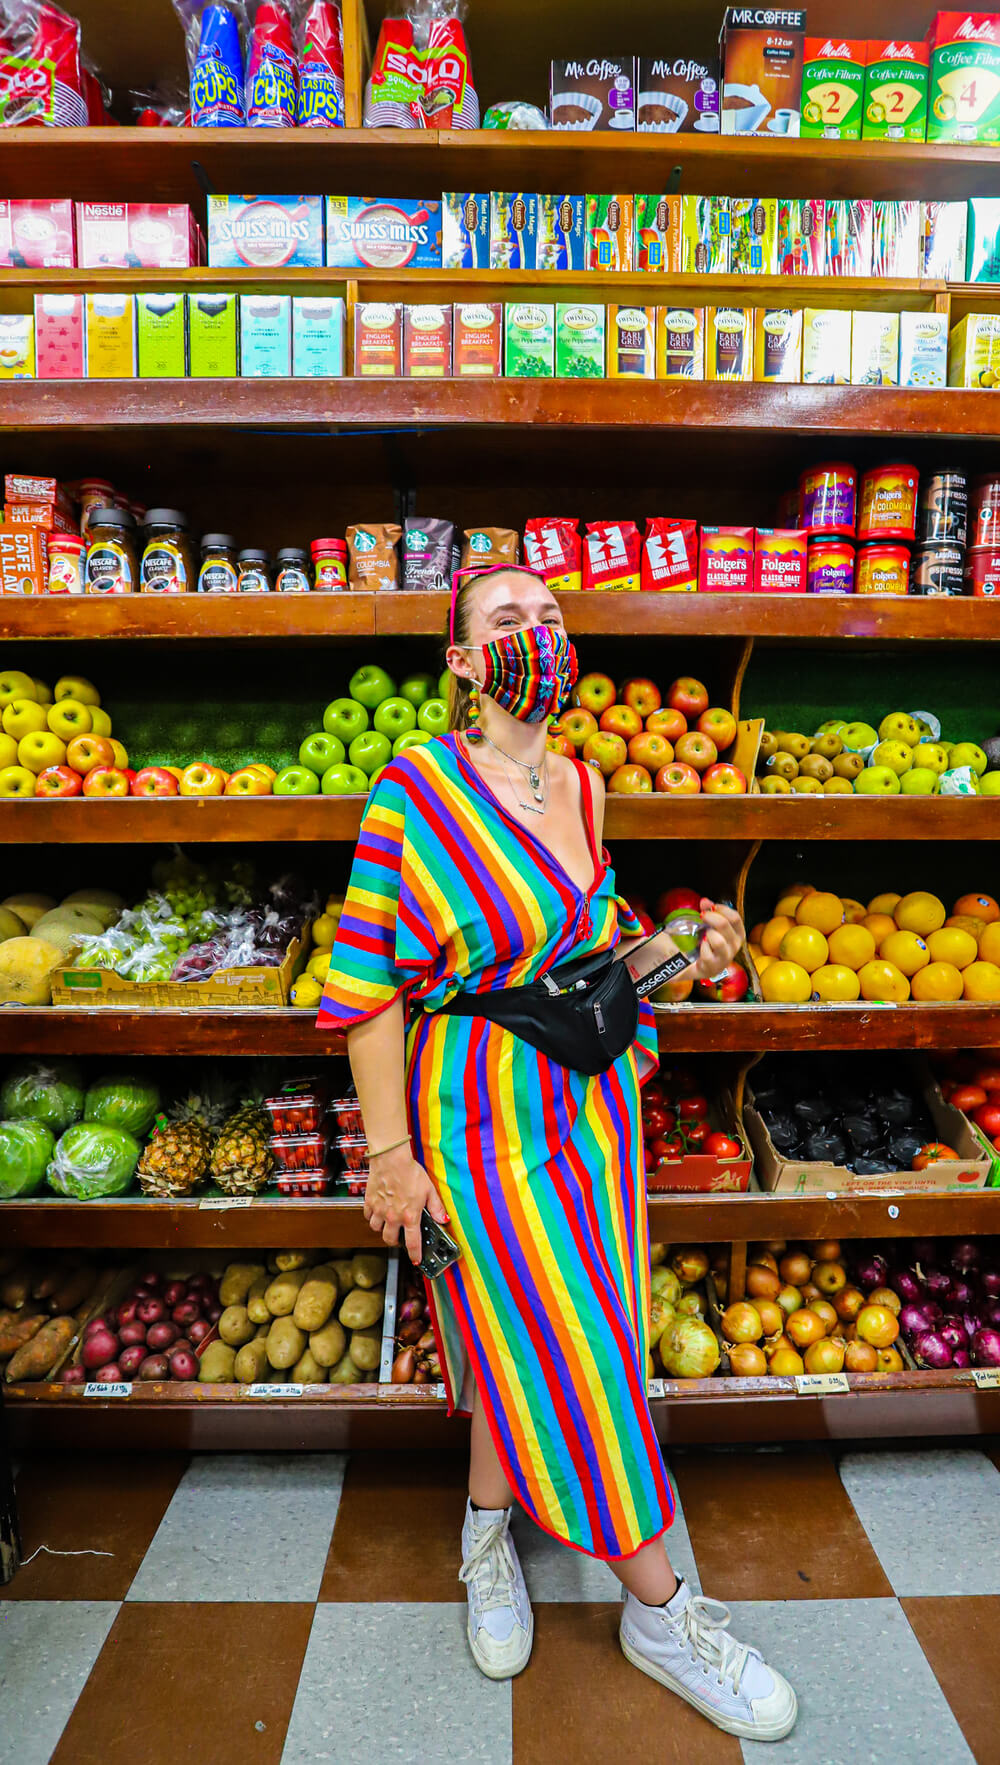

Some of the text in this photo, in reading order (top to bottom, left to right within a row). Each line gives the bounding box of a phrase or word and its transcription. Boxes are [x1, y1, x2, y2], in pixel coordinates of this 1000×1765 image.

[766, 37, 783, 46] 8-12
[938, 51, 972, 68] Coffee
[196, 61, 229, 80] PLASTIC
[386, 53, 460, 88] SOLO
[564, 59, 622, 81] Mr. Coffee
[651, 59, 709, 82] Mr. Coffee
[806, 68, 862, 81] Coffee Filters
[870, 69, 925, 82] Coffee Filters
[195, 73, 238, 108] CUPS
[301, 79, 333, 92] LASTIC
[254, 78, 296, 116] CUPS
[221, 220, 268, 241] SWISS
[340, 222, 387, 242] SWISS
[480, 215, 488, 237] Magic
[528, 214, 536, 237] Magic
[621, 338, 642, 346] GREY
[670, 332, 690, 340] EARL
[719, 332, 740, 340] EARL
[875, 490, 902, 501] Folgers
[14, 534, 31, 572] CAFE
[40, 532, 48, 558] CAFE
[0, 534, 18, 594] LA LLAV
[356, 560, 391, 569] COLOMBIA
[708, 558, 747, 572] Folgers
[762, 558, 800, 574] Folgers
[761, 574, 784, 582] CLASSIC
[872, 572, 898, 581] Folgers
